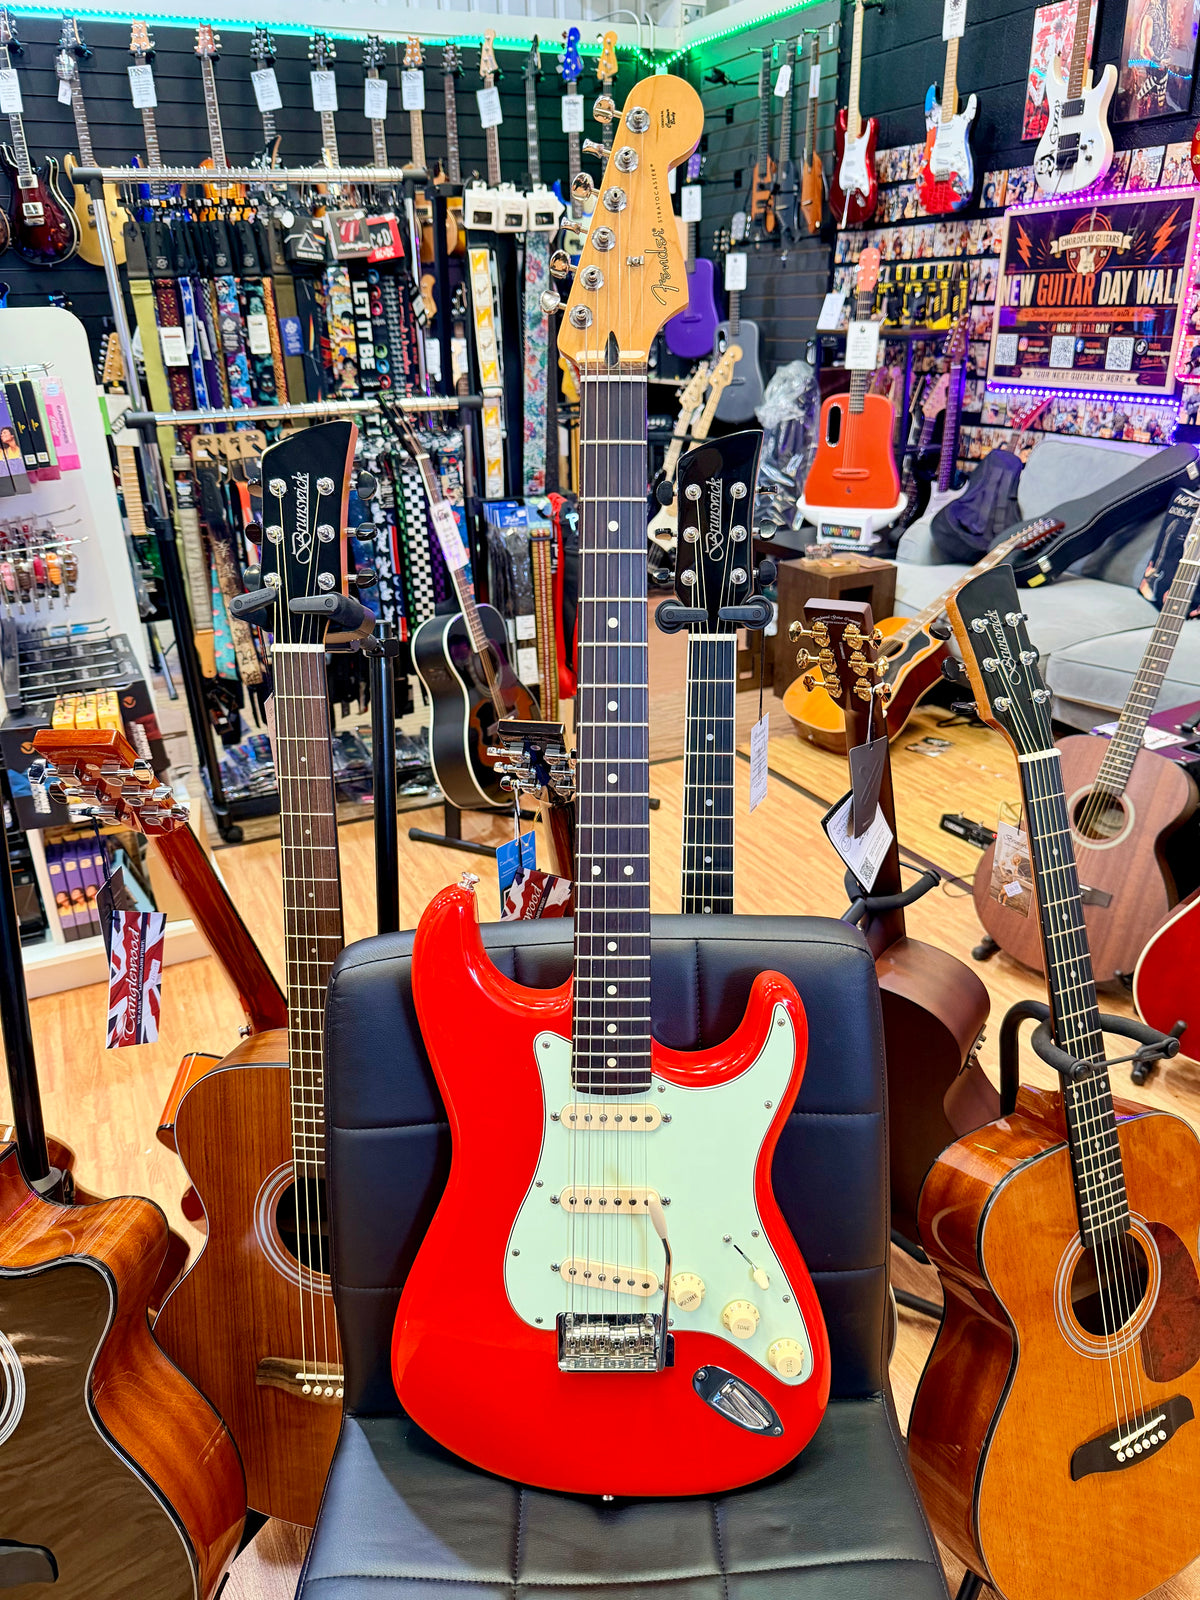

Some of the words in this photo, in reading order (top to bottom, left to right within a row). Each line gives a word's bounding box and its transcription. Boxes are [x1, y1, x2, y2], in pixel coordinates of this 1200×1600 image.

[1061, 234, 1094, 247] CHORDPLAY
[1095, 233, 1121, 244] GUITARS
[644, 228, 680, 305] Fender
[352, 281, 371, 318] LET
[1000, 275, 1036, 307] NEW
[1037, 273, 1095, 306] GUITAR
[1098, 270, 1133, 305] DAY
[356, 321, 374, 342] IT
[1051, 322, 1110, 333] #NEWGUITARDAY
[358, 343, 376, 370] BE
[1071, 371, 1095, 381] GUITAR
[291, 472, 312, 564] Brunswick
[705, 477, 724, 561] Brunswick
[984, 609, 1021, 685] Brunswick
[122, 926, 140, 1041] Tanglewood
[678, 1293, 698, 1307] VOLUME
